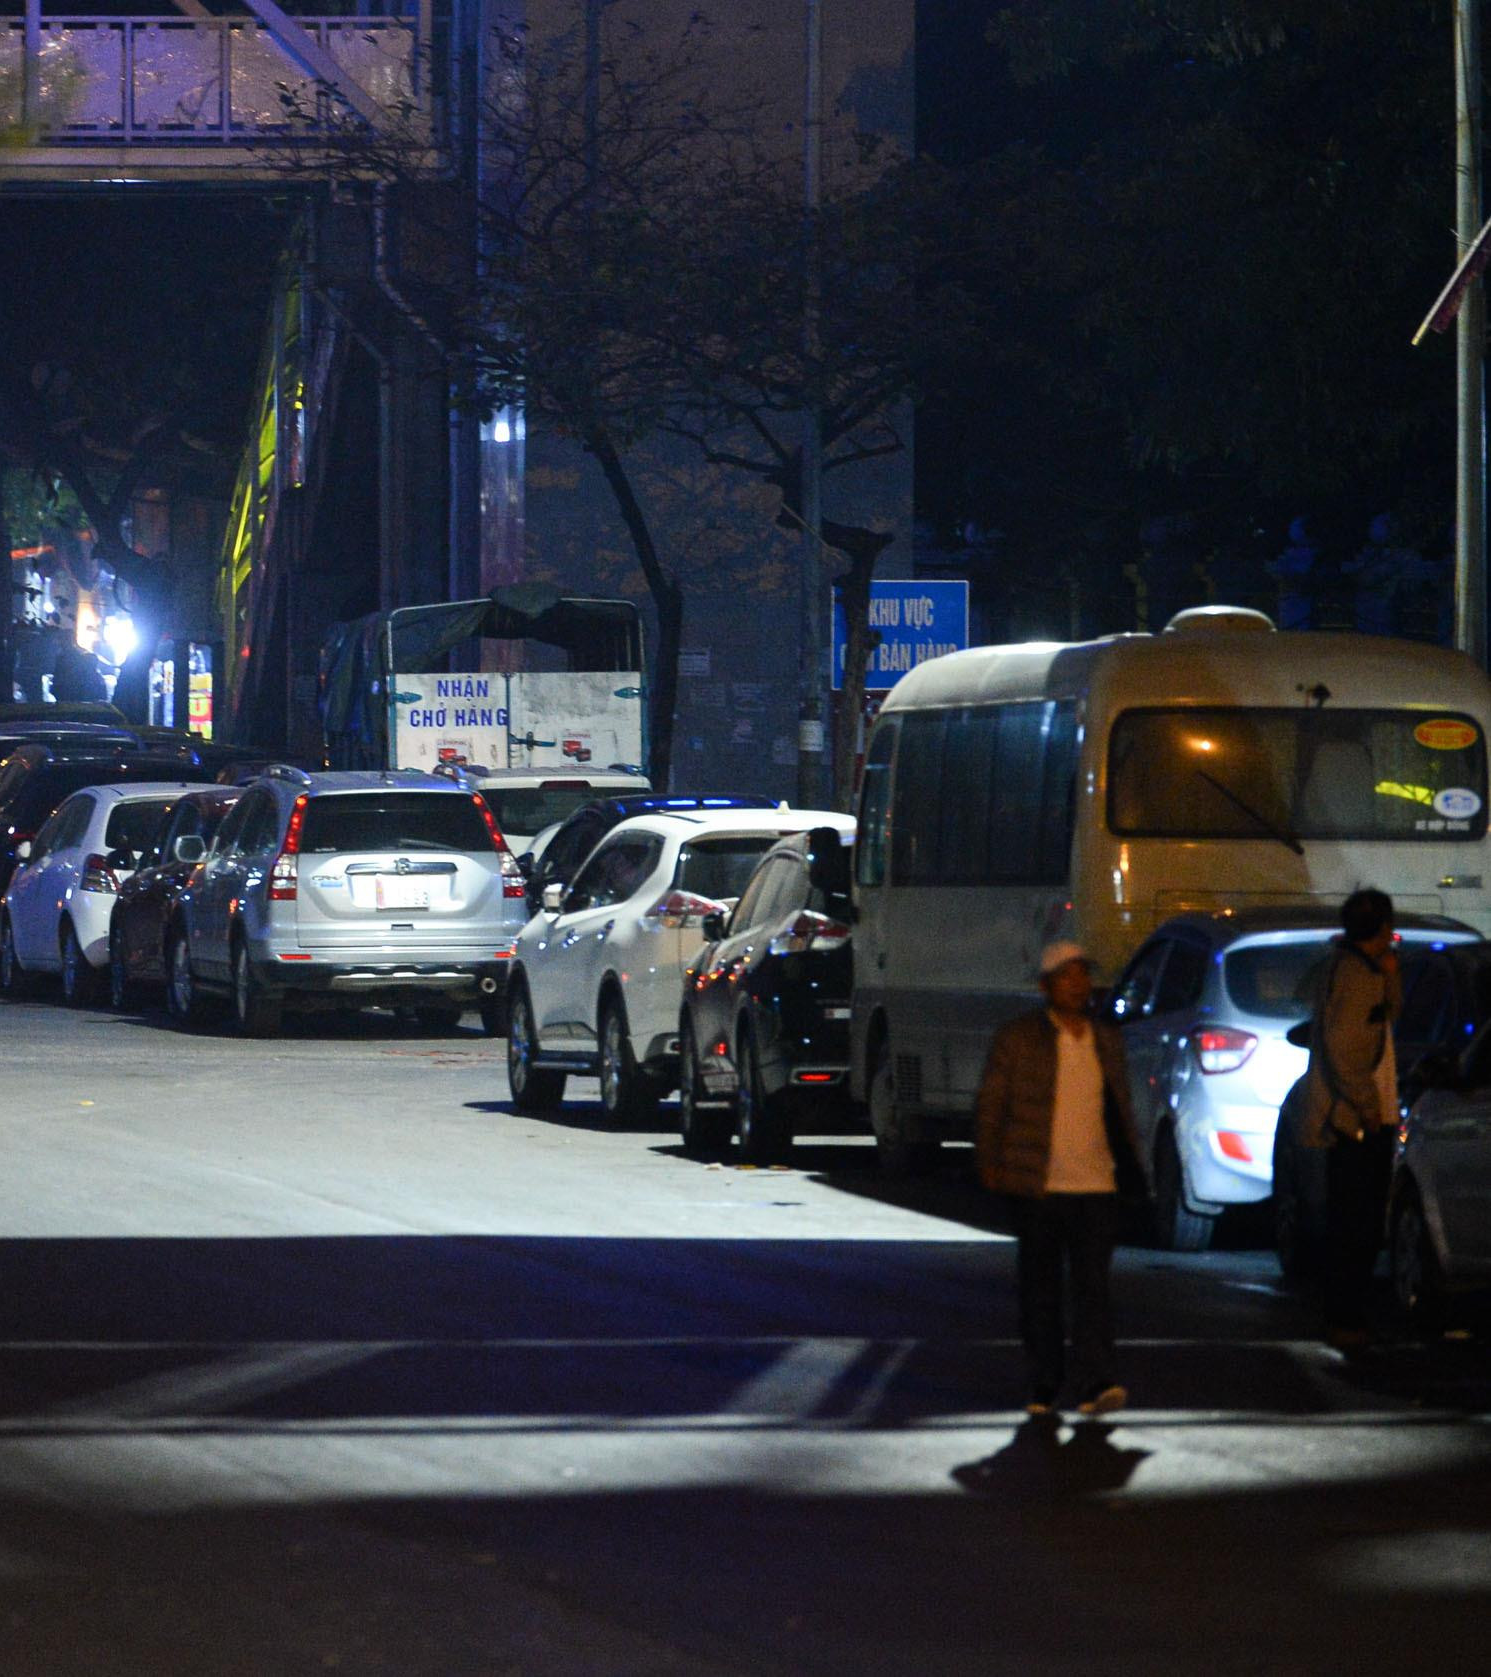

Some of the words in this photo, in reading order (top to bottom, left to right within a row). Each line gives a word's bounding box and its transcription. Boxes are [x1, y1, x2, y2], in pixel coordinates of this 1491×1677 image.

[868, 598, 900, 626] KHU
[904, 595, 934, 630] VỰC
[879, 638, 911, 672] BÁN
[437, 675, 489, 702] NHẬN
[410, 702, 447, 727] CHỞ
[455, 704, 509, 727] HÀNG
